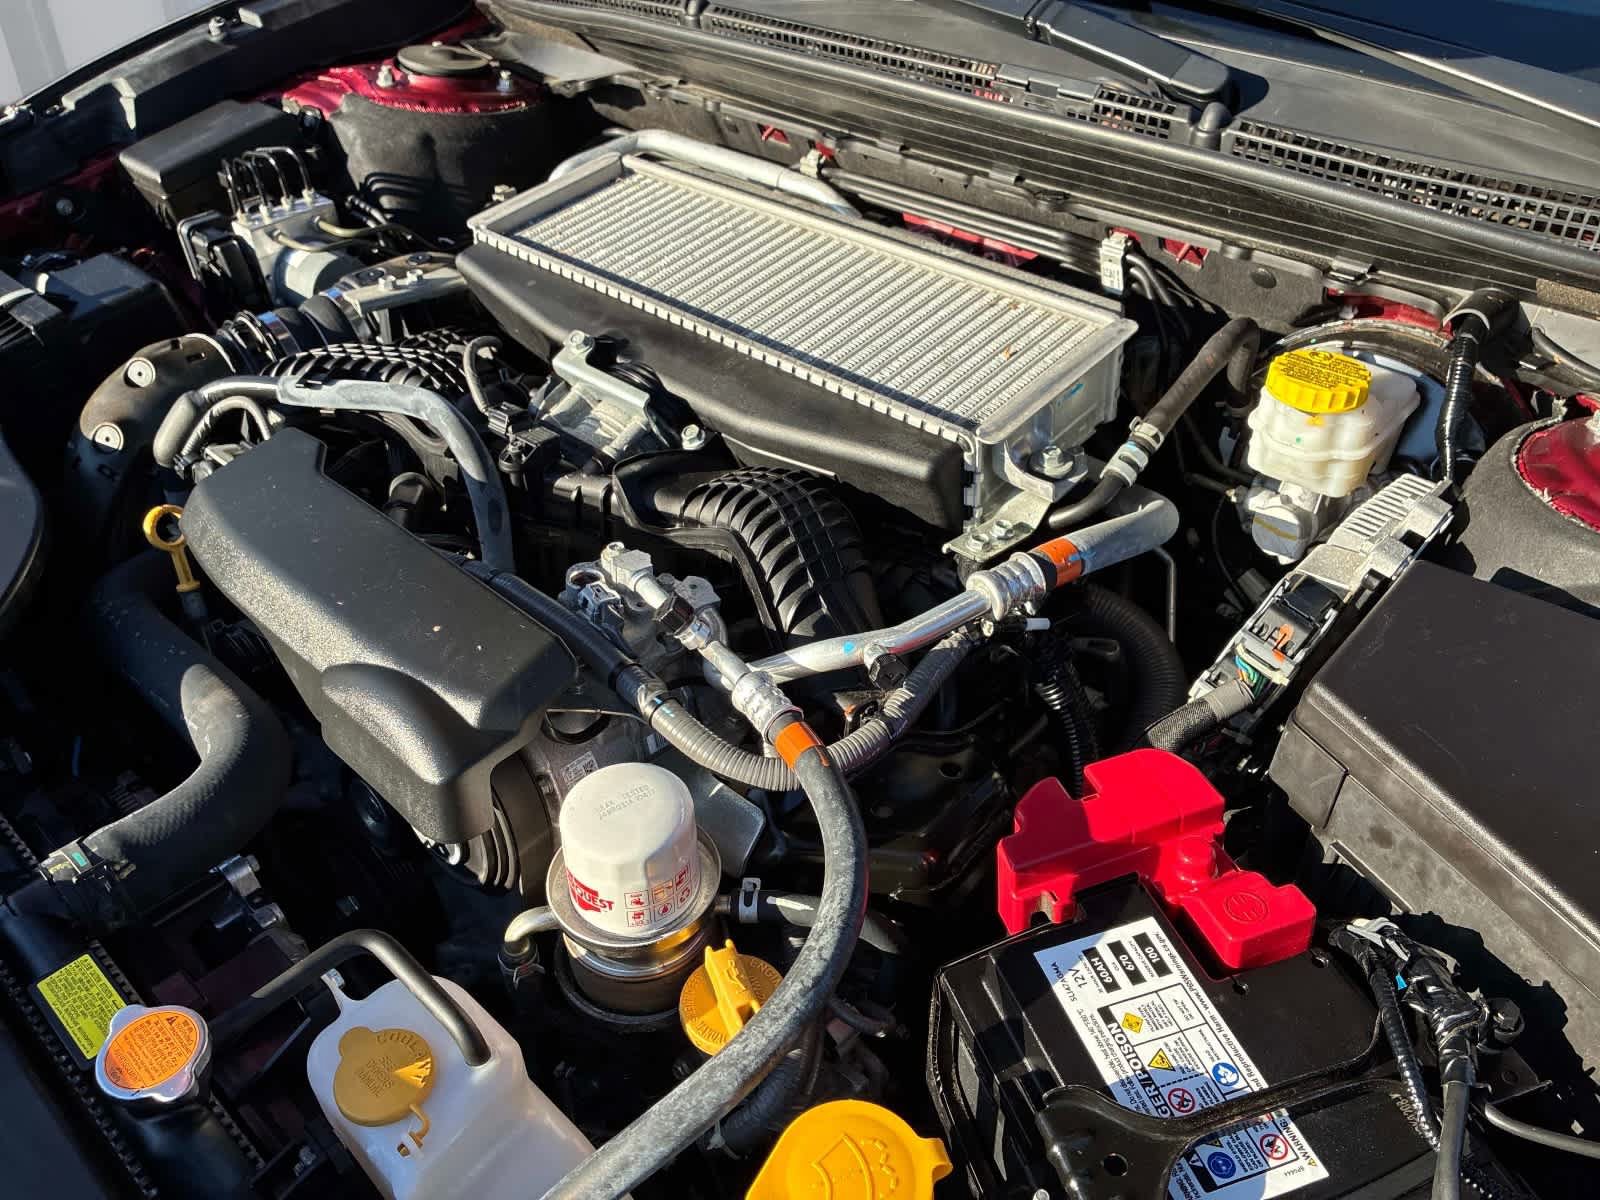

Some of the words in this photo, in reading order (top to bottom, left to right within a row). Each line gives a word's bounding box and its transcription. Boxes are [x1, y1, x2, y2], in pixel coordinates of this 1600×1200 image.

[1117, 953, 1136, 971] 670
[1143, 945, 1161, 963] 100
[1067, 966, 1089, 988] 12V
[1089, 956, 1114, 984] 60AH
[1206, 1014, 1224, 1032] Harm
[1219, 1032, 1257, 1077] Reproductive
[1105, 1021, 1174, 1118] GER/POISON
[1276, 1118, 1312, 1160] WARNING:
